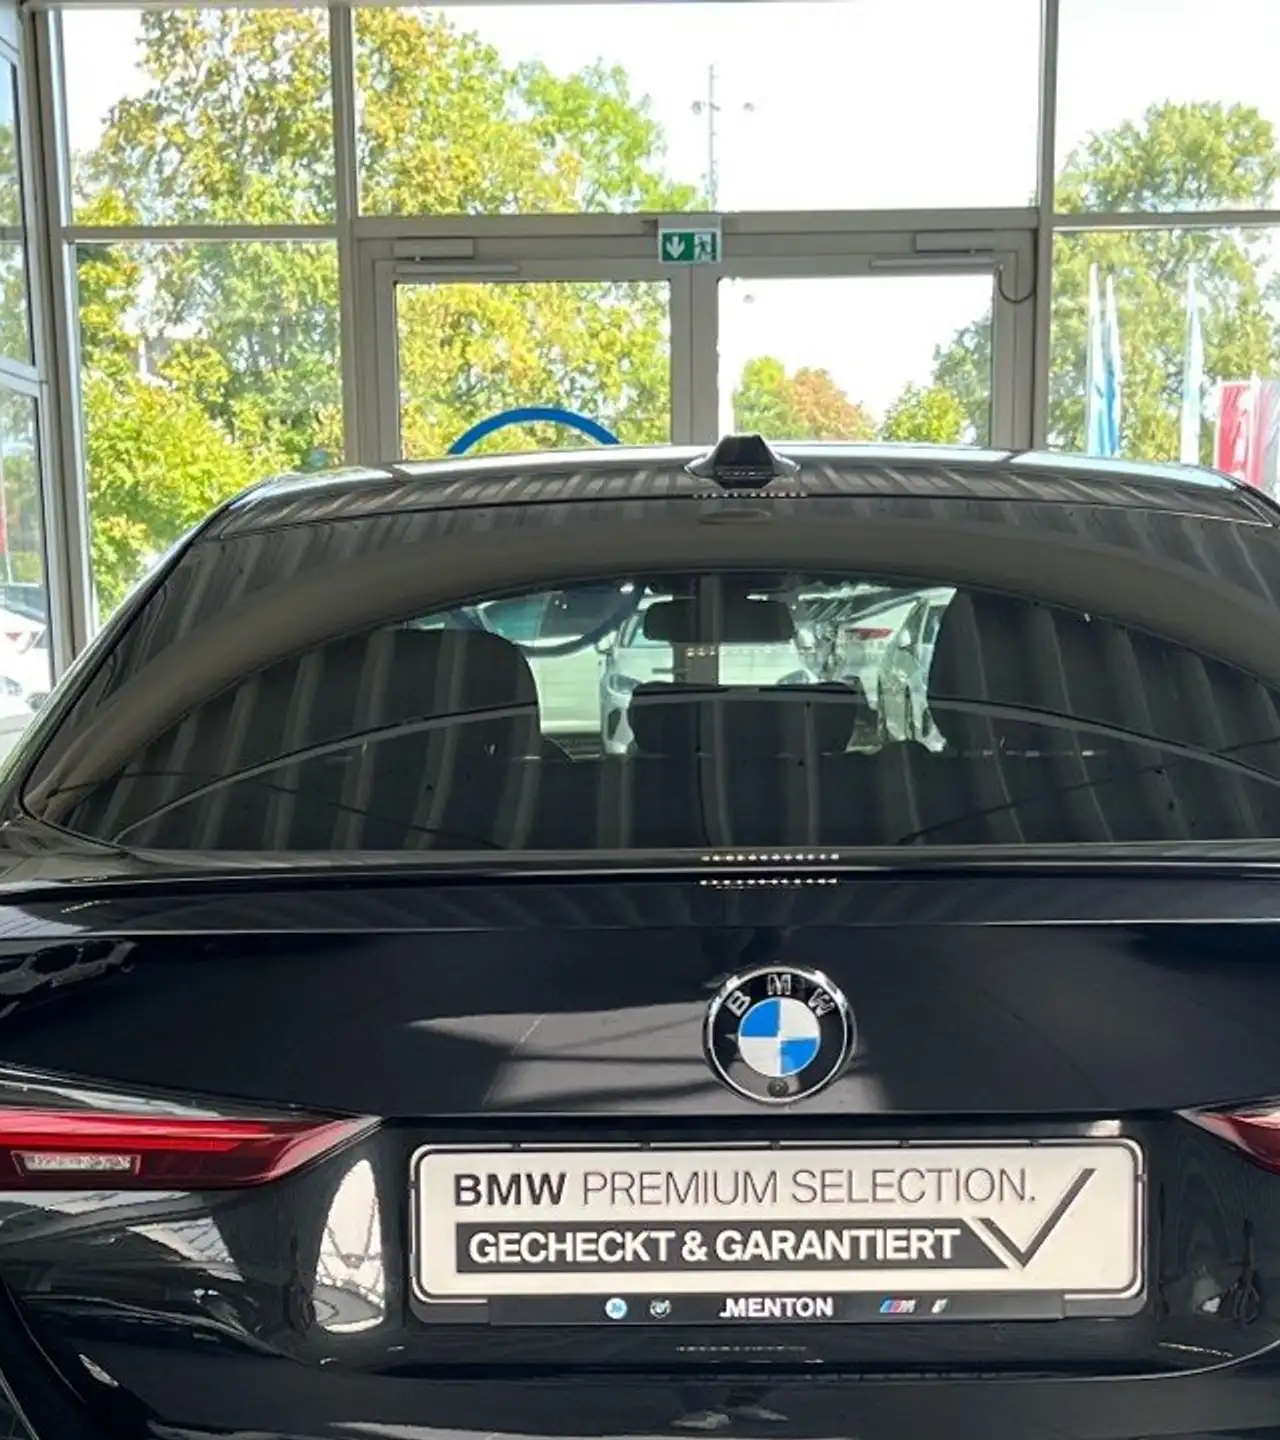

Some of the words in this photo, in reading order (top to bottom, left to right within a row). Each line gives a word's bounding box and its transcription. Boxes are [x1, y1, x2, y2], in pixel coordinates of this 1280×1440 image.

[725, 974, 835, 1017] BMW
[454, 1172, 567, 1206] BMW
[583, 1170, 778, 1206] PREMIUM
[791, 1167, 1036, 1204] SELECTION.
[469, 1230, 675, 1264] GECHECKT
[681, 1230, 708, 1263] &
[716, 1227, 961, 1263] GARANTIERT
